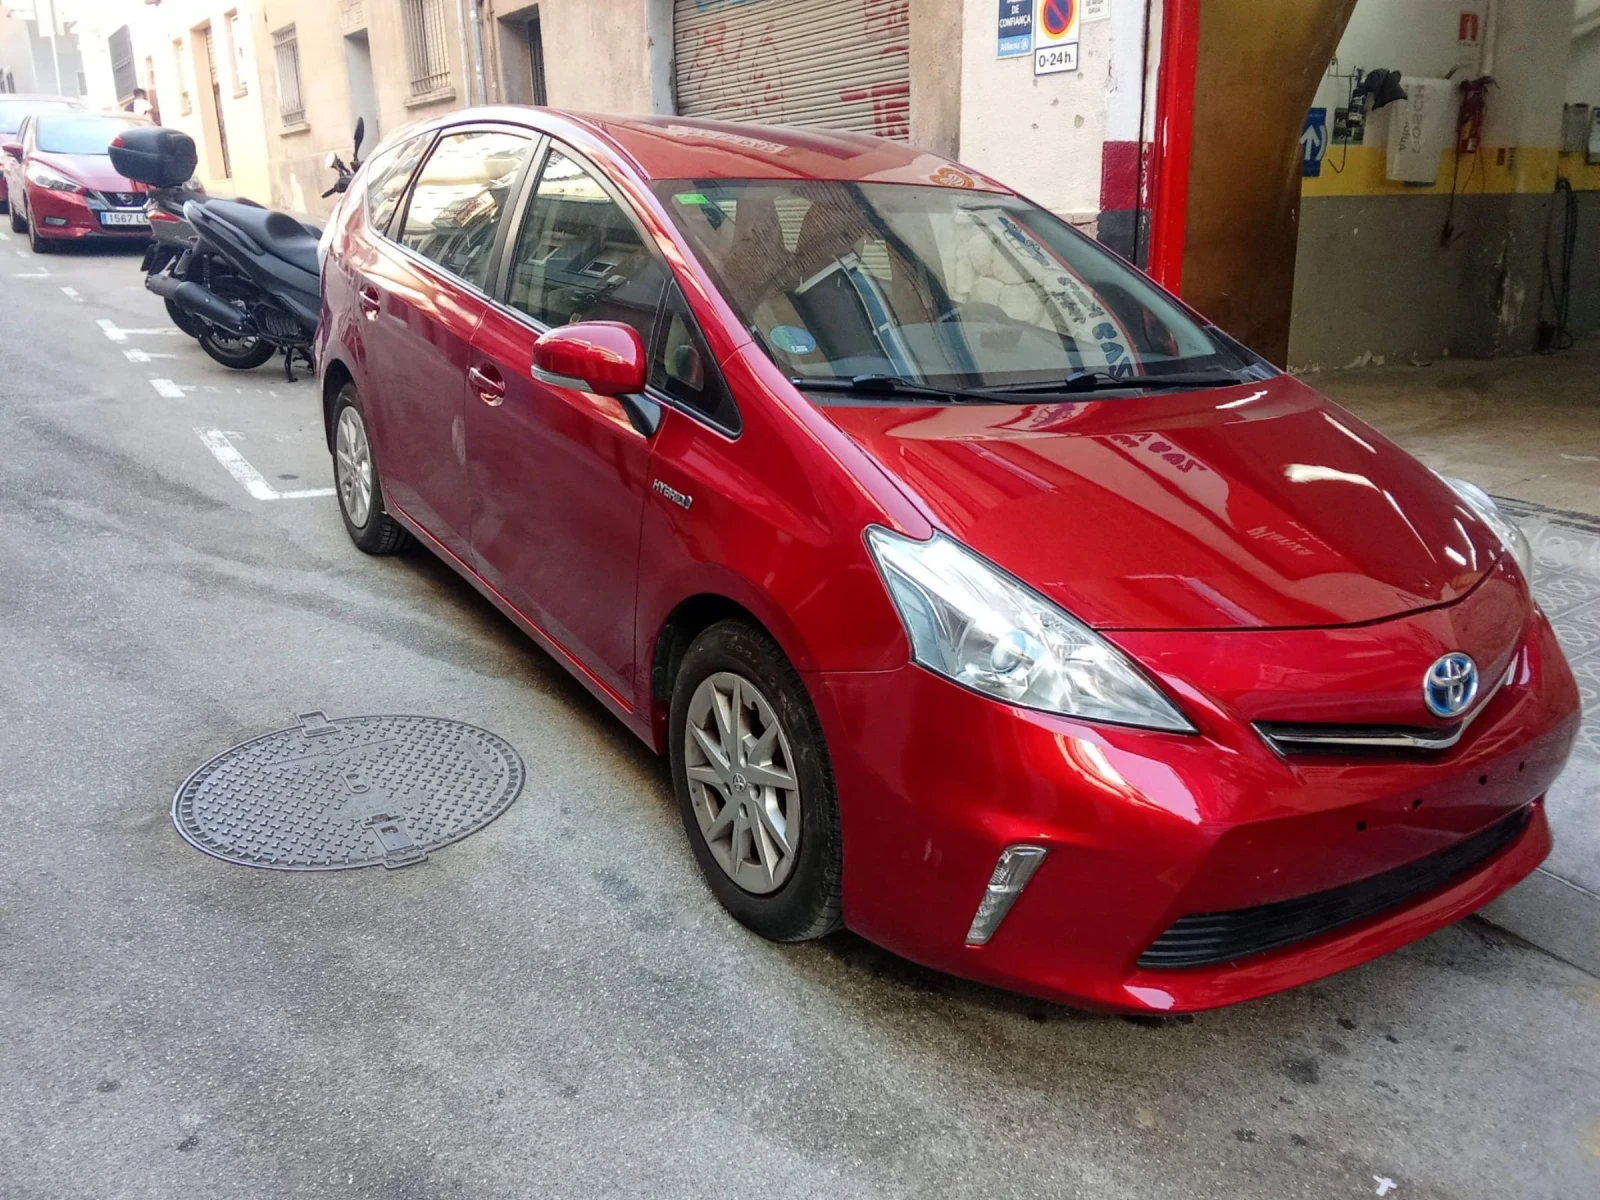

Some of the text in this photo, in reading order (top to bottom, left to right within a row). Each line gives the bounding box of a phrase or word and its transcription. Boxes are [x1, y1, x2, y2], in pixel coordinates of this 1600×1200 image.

[1011, 4, 1020, 14] DE
[999, 14, 1031, 28] CONFIANÇA
[109, 214, 133, 223] 1567
[652, 478, 688, 508] HYBRID
